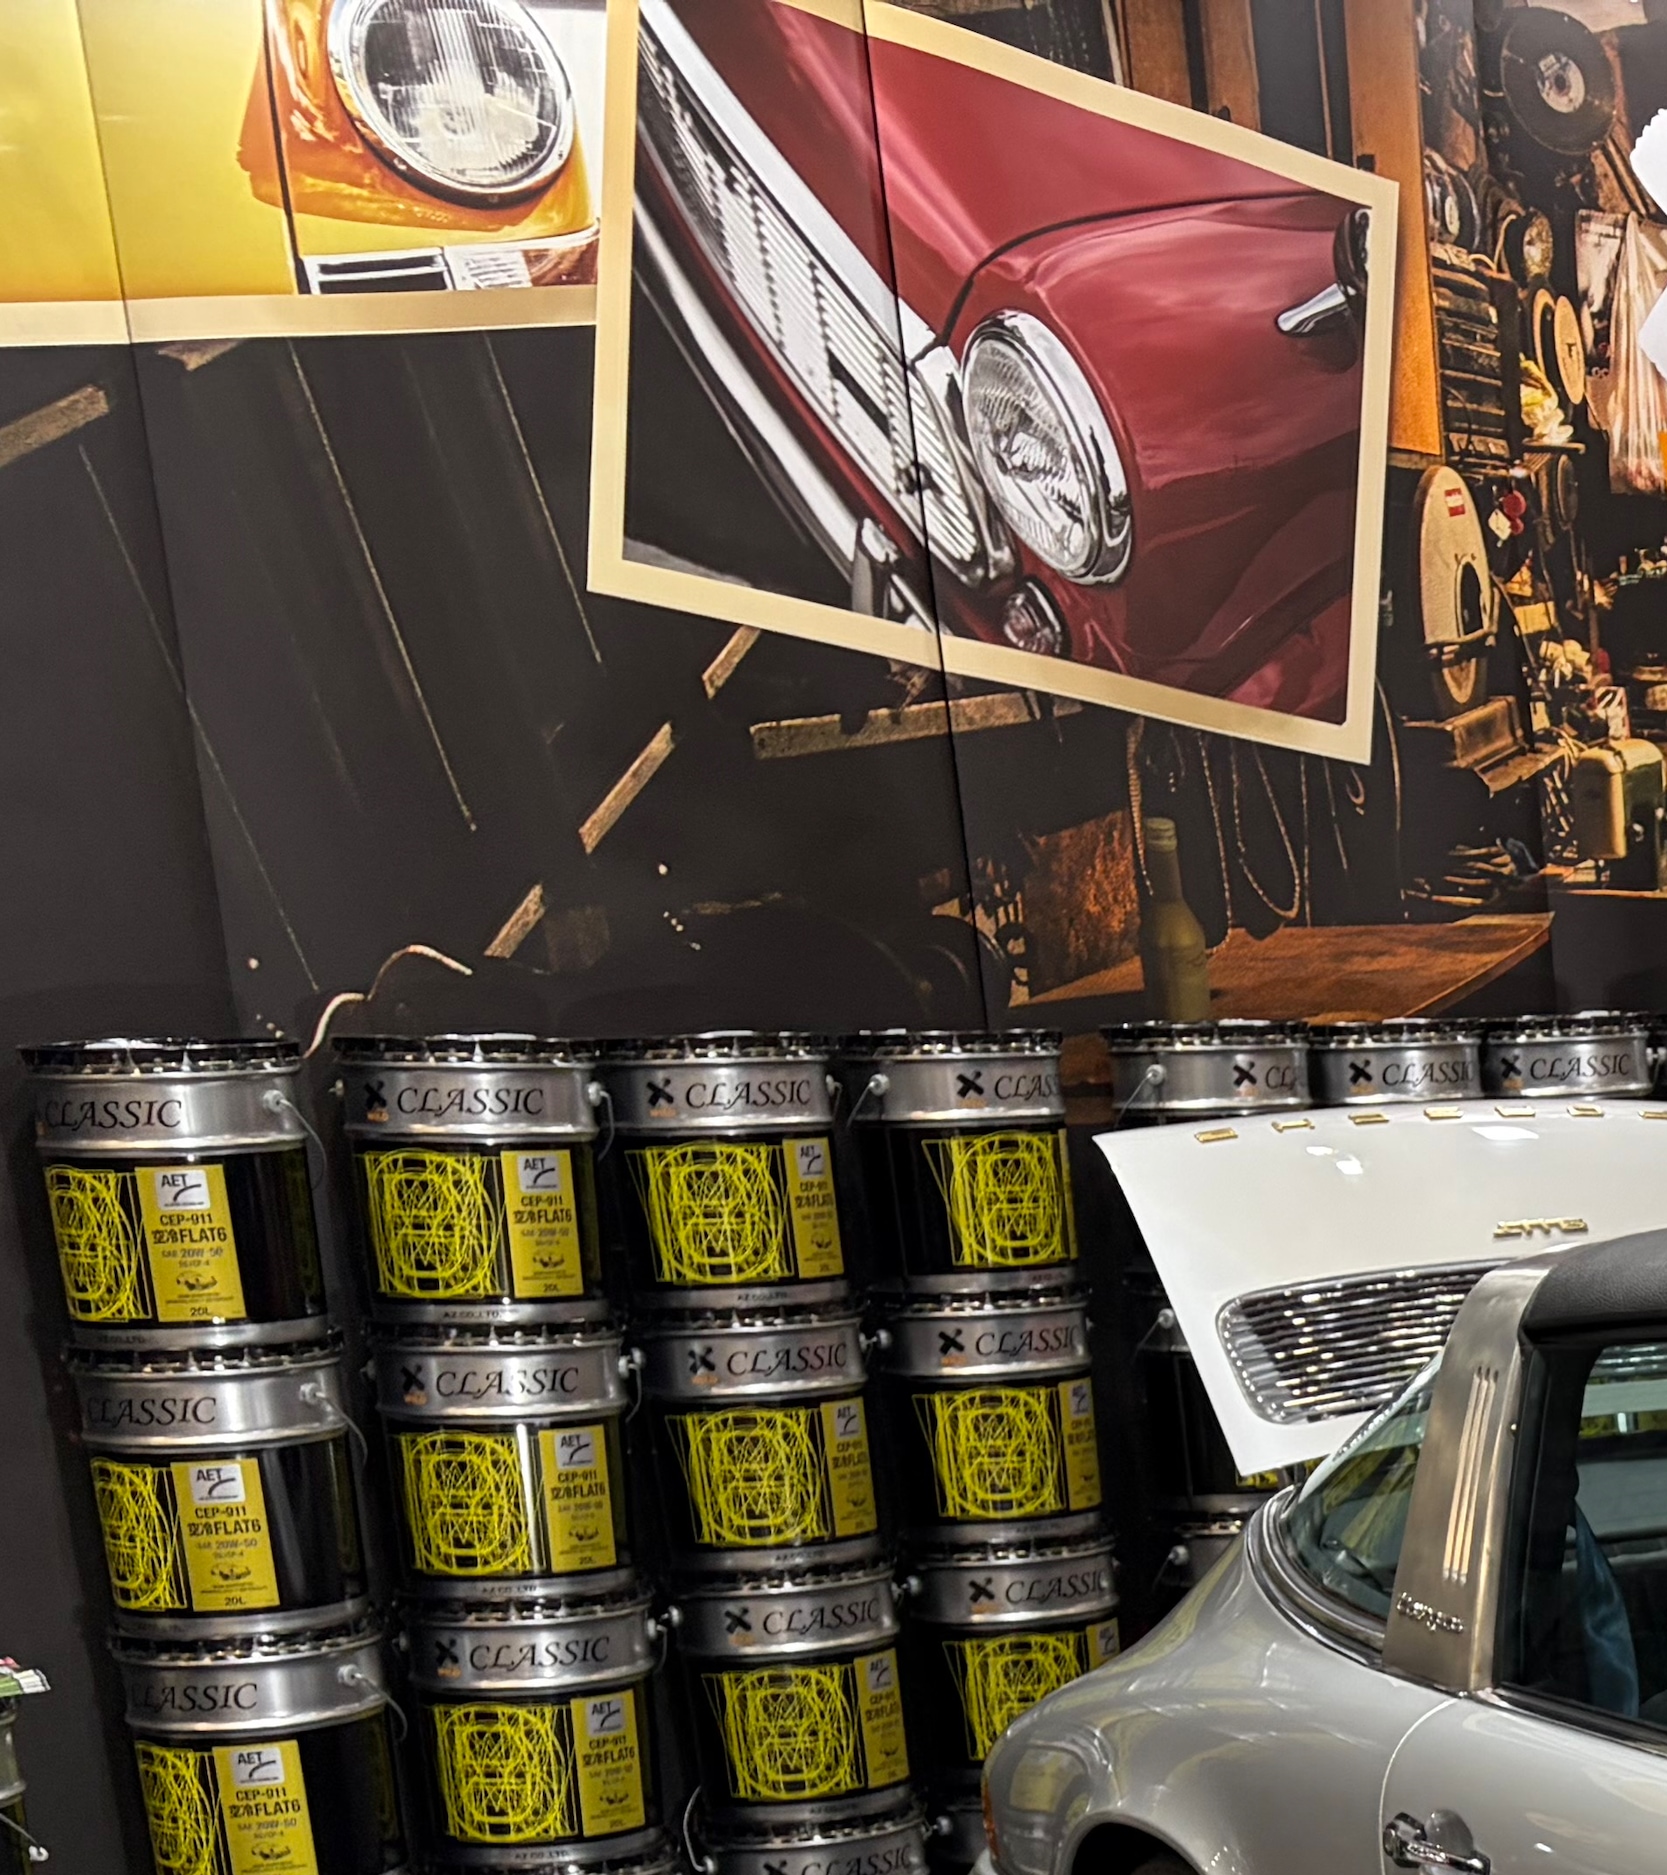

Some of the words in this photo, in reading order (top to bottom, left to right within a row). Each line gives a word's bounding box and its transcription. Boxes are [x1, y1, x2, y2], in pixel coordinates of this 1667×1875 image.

[1529, 1053, 1632, 1081] CLASSIC
[397, 1086, 546, 1119] CLASSIC
[685, 1079, 812, 1110] CLASSIC
[46, 1099, 183, 1132] CLASSIC
[160, 1173, 191, 1189] AET
[159, 1213, 213, 1226] CEP-911
[726, 1342, 848, 1377] CLASSIC
[436, 1366, 580, 1398] CLASSIC
[196, 1468, 223, 1483] AET
[195, 1506, 248, 1519] CEP-911
[762, 1597, 881, 1637] CLASSIC
[469, 1636, 610, 1673] CLASSIC
[237, 1750, 263, 1766] AET
[235, 1786, 287, 1802] CEP-911
